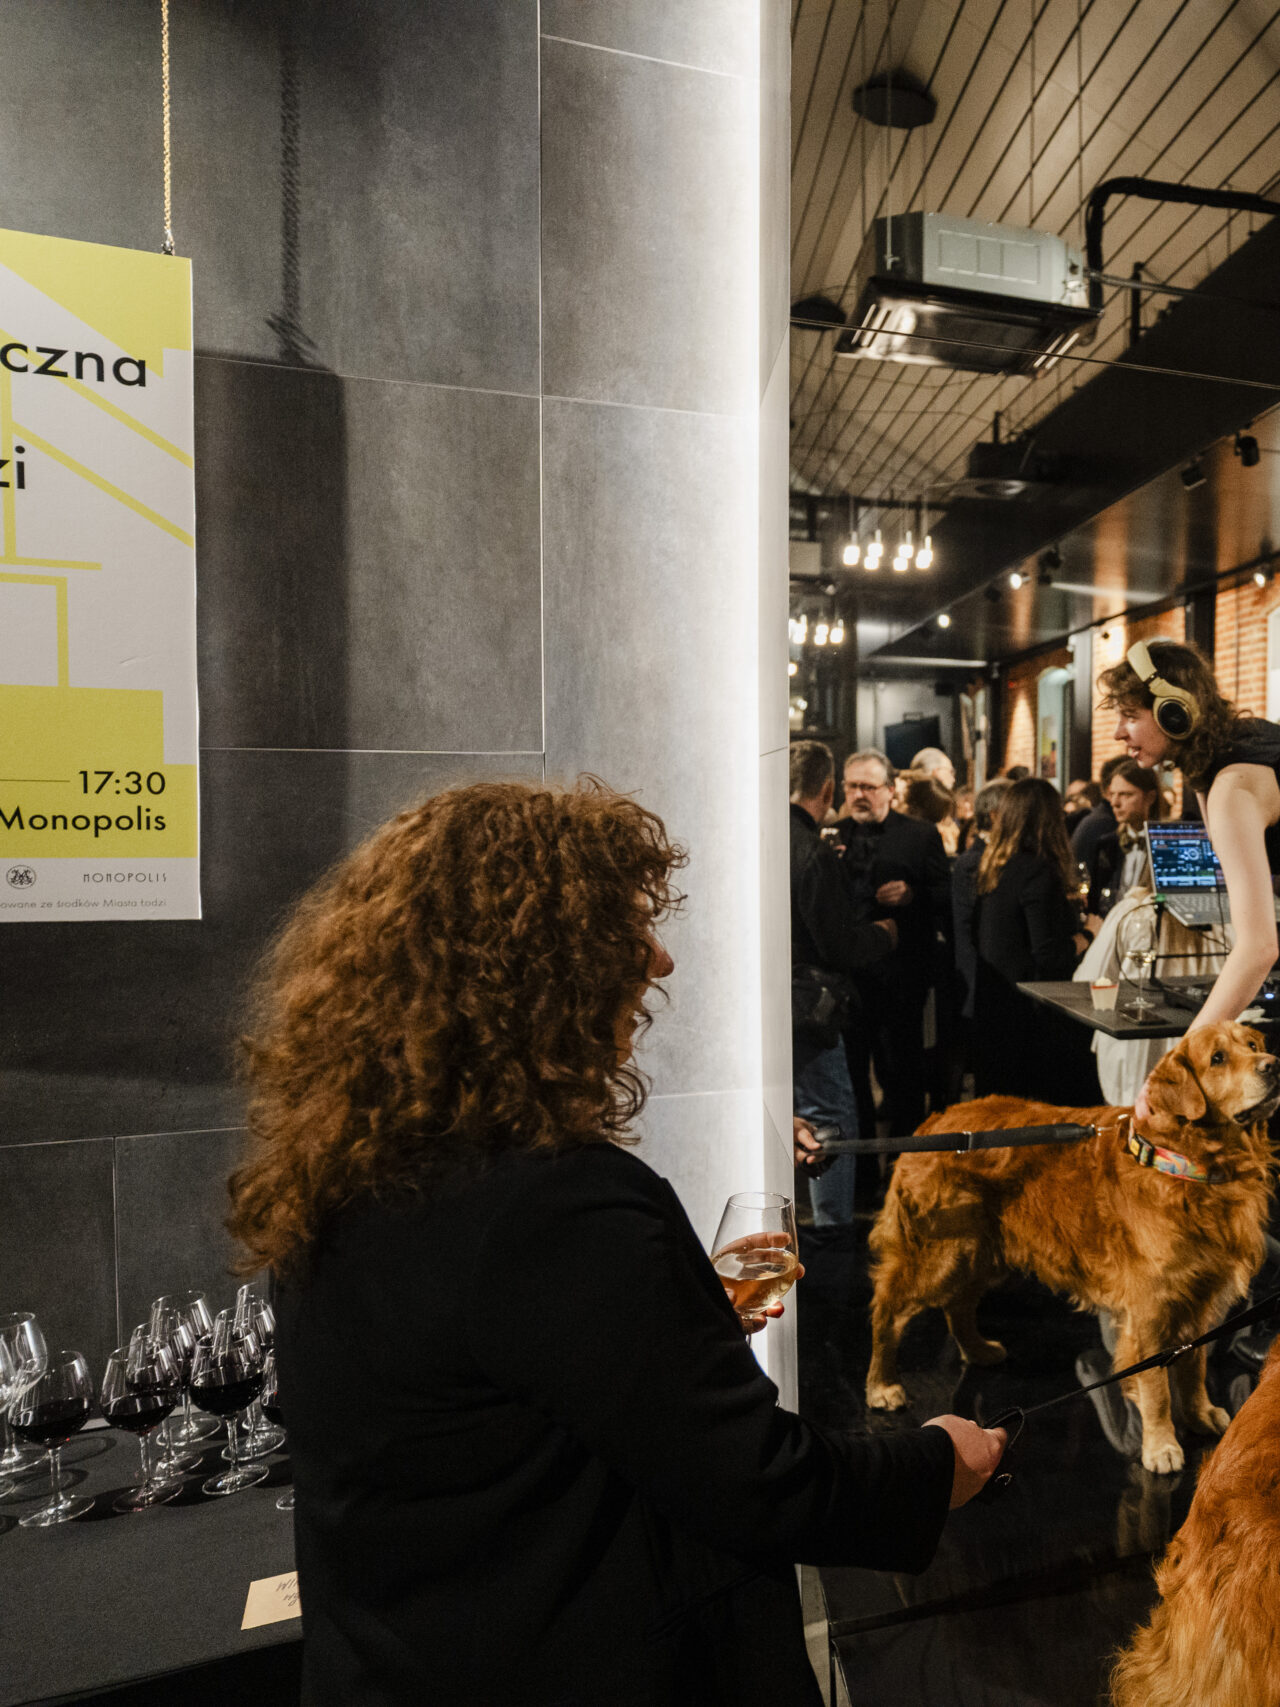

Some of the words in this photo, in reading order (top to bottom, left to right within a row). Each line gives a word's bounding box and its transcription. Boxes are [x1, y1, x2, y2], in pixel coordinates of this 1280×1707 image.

[0, 343, 147, 387] czna
[78, 770, 166, 795] 17:30
[0, 805, 166, 838] Monopolis
[83, 872, 167, 883] MONOPOLIS
[103, 898, 137, 908] Miasta
